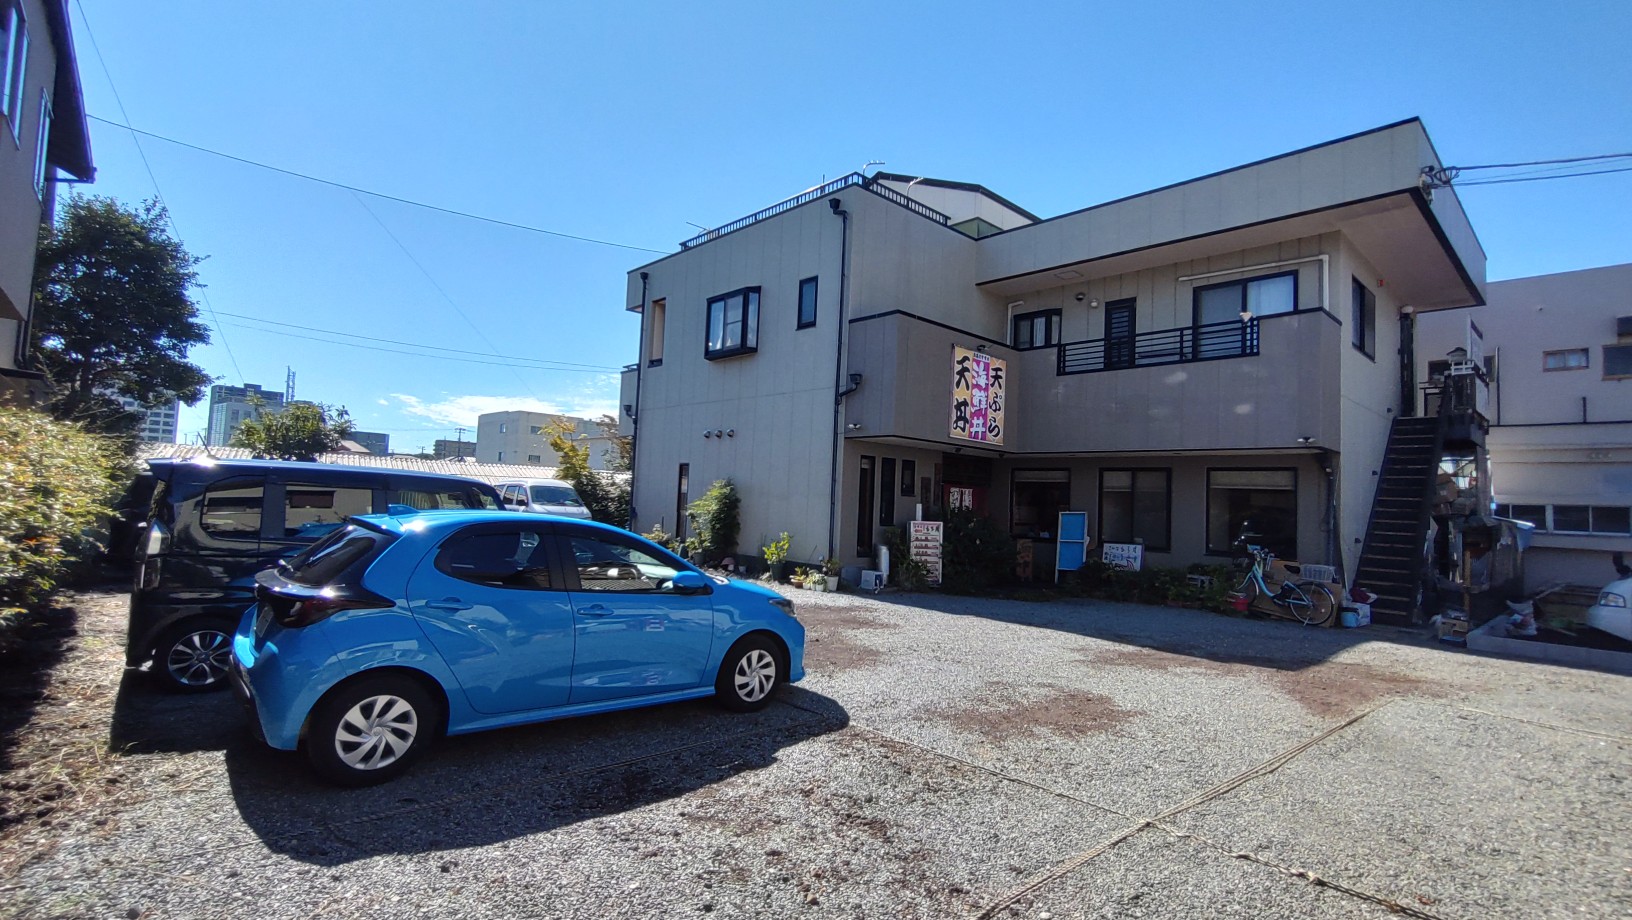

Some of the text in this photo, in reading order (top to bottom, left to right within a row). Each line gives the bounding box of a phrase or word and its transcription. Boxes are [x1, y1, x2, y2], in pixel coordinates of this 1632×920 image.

[953, 355, 971, 433] 天丼
[988, 367, 1003, 437] 天ぷら
